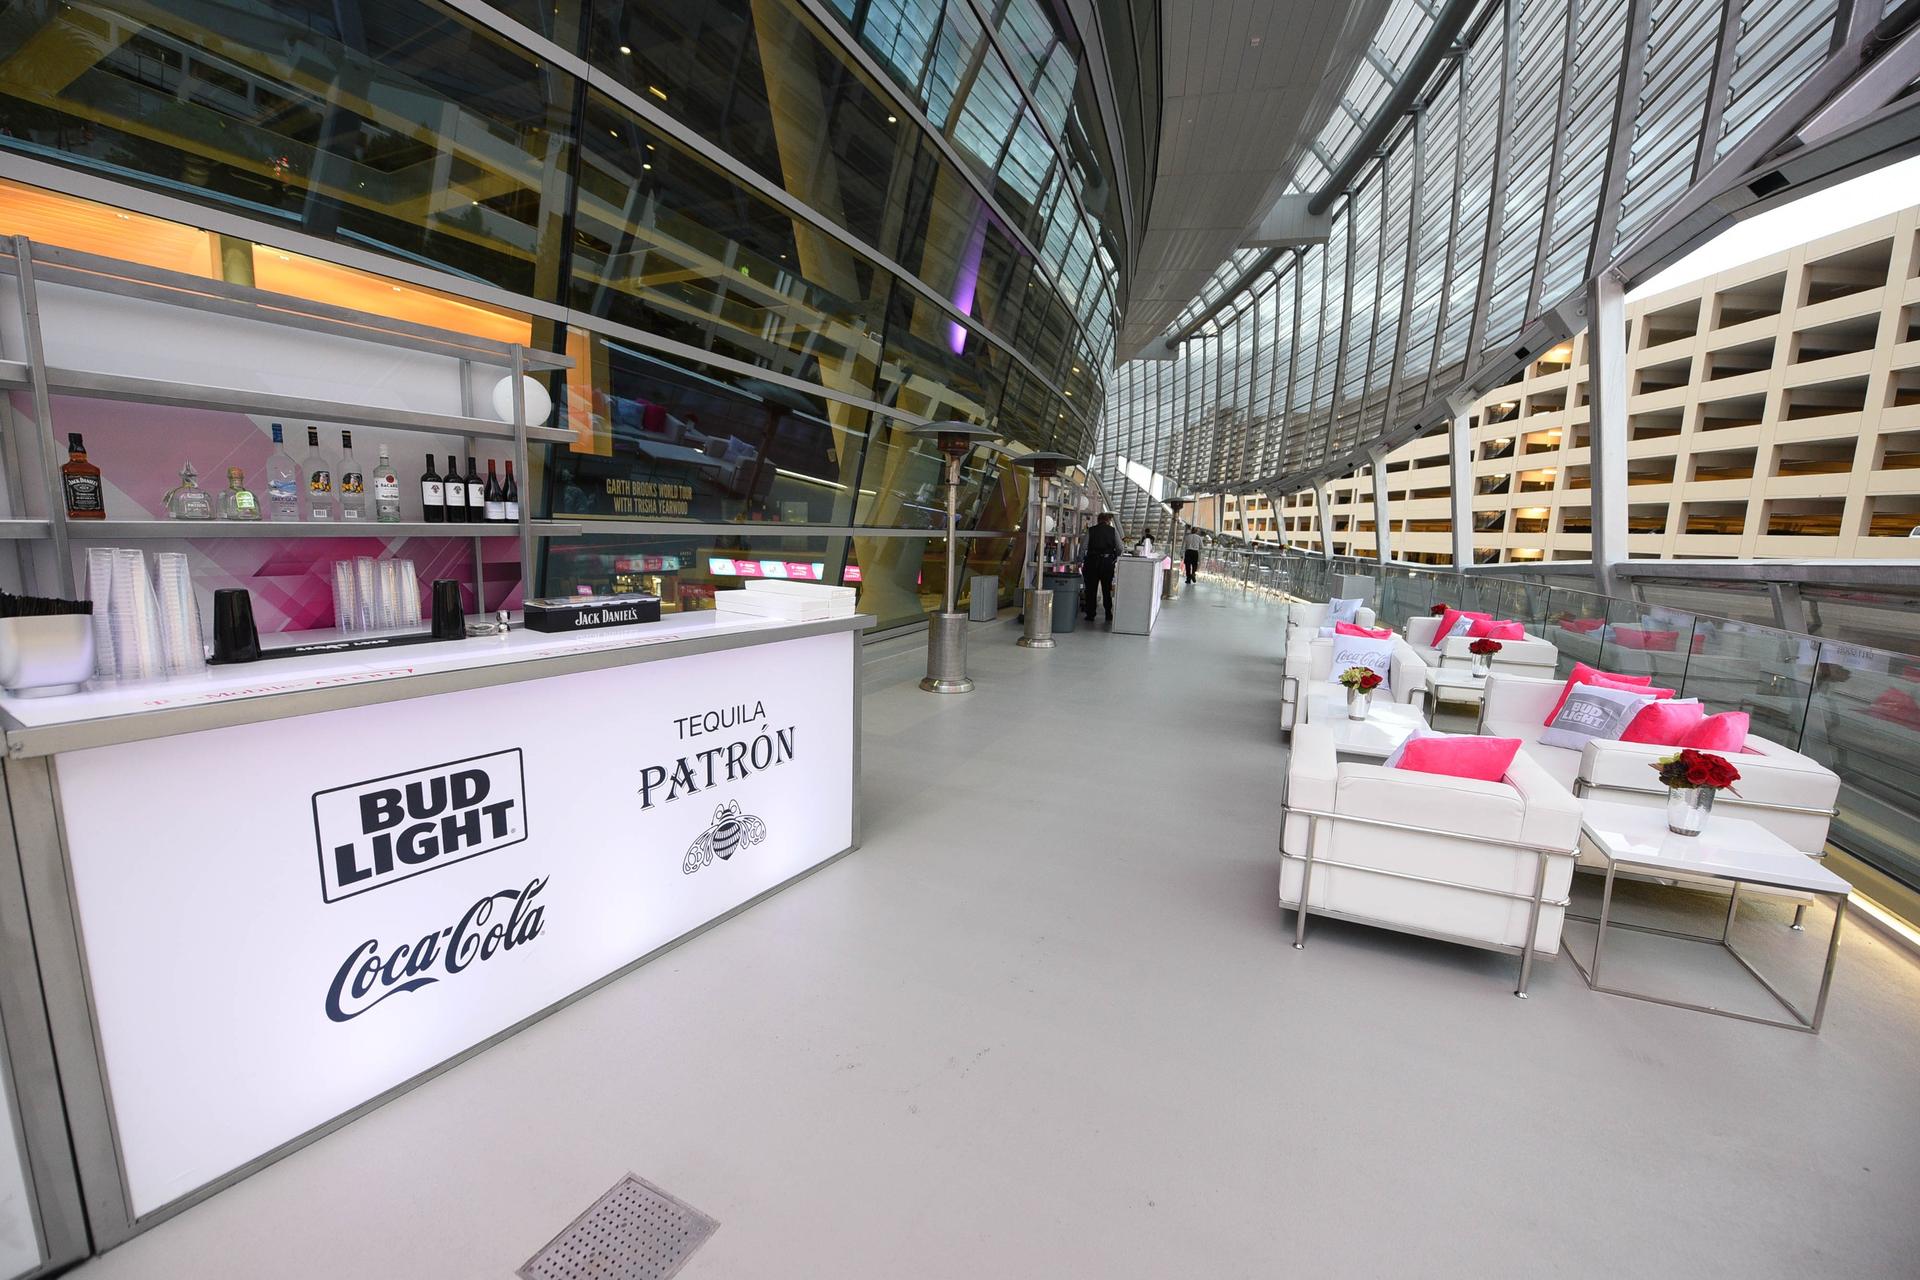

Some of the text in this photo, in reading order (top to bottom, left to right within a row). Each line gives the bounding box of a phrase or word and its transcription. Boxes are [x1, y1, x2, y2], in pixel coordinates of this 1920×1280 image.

[606, 479, 693, 500] GARTH BROOKS WORLD TOUR
[613, 497, 689, 515] WITH TRISHA YEARWOOD
[574, 607, 639, 627] JACK DANIEL'S
[673, 700, 766, 740] TEQUILA
[1562, 710, 1604, 727] LIGHT
[1572, 702, 1603, 717] BUD
[637, 723, 797, 811] PATRÓN
[359, 769, 490, 835] BUD
[334, 798, 515, 888] LIGHT
[325, 873, 551, 1023] Coca-Cola
